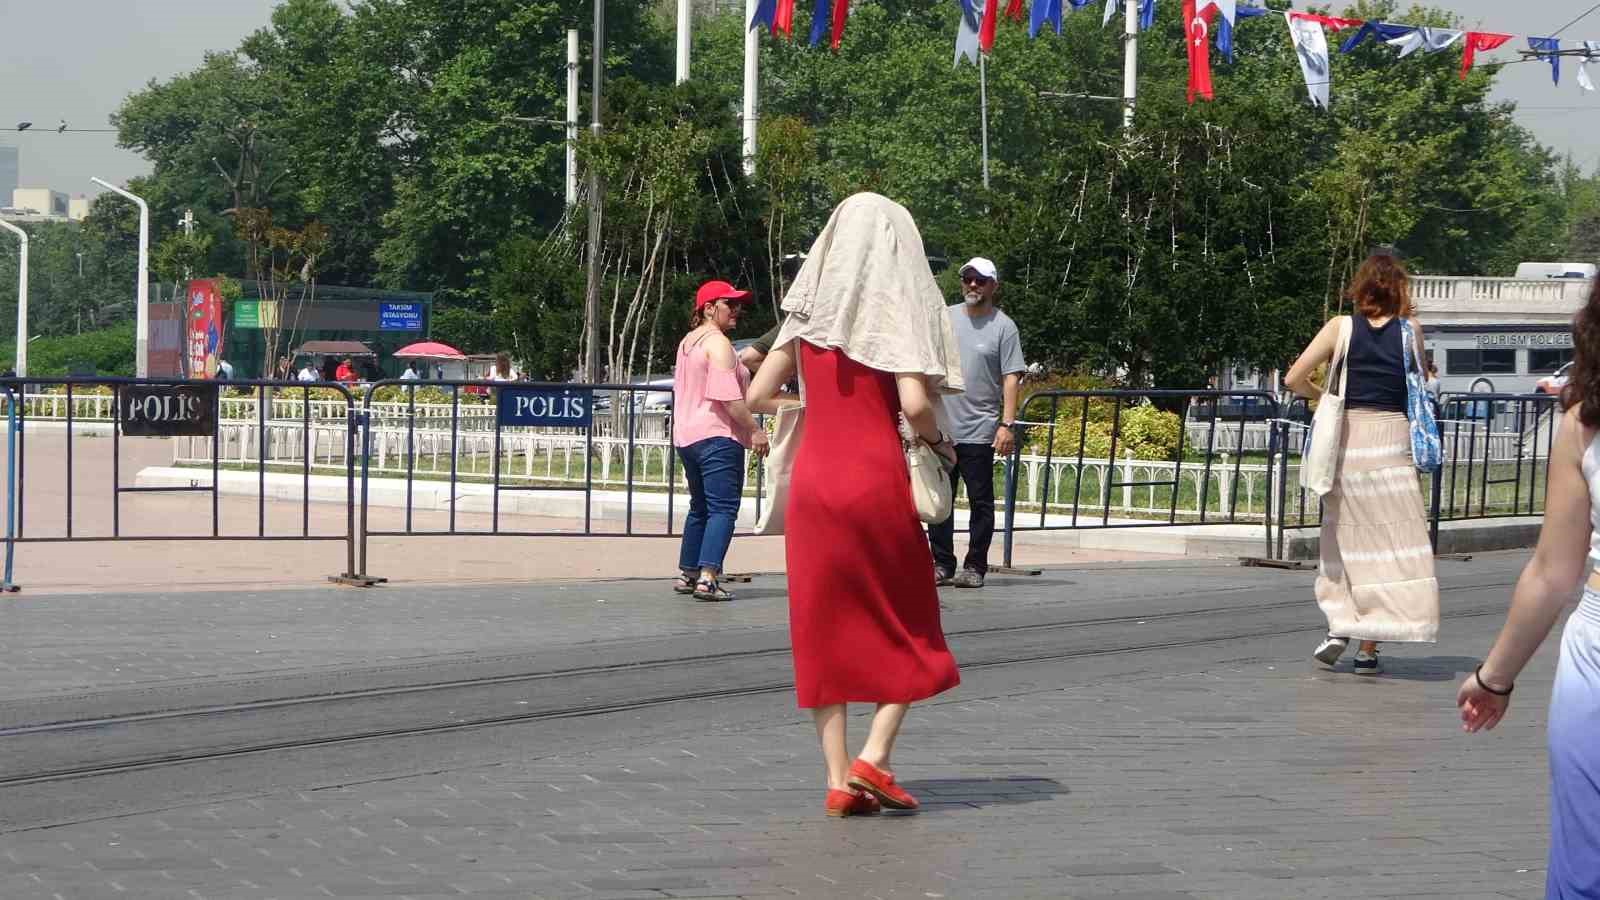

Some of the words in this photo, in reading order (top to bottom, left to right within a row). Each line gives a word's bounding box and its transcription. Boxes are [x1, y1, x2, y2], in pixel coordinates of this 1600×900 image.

[1475, 335, 1525, 345] TOURISM
[1529, 335, 1569, 345] POLICE
[127, 393, 201, 421] POLİS
[514, 390, 585, 418] POLİS
